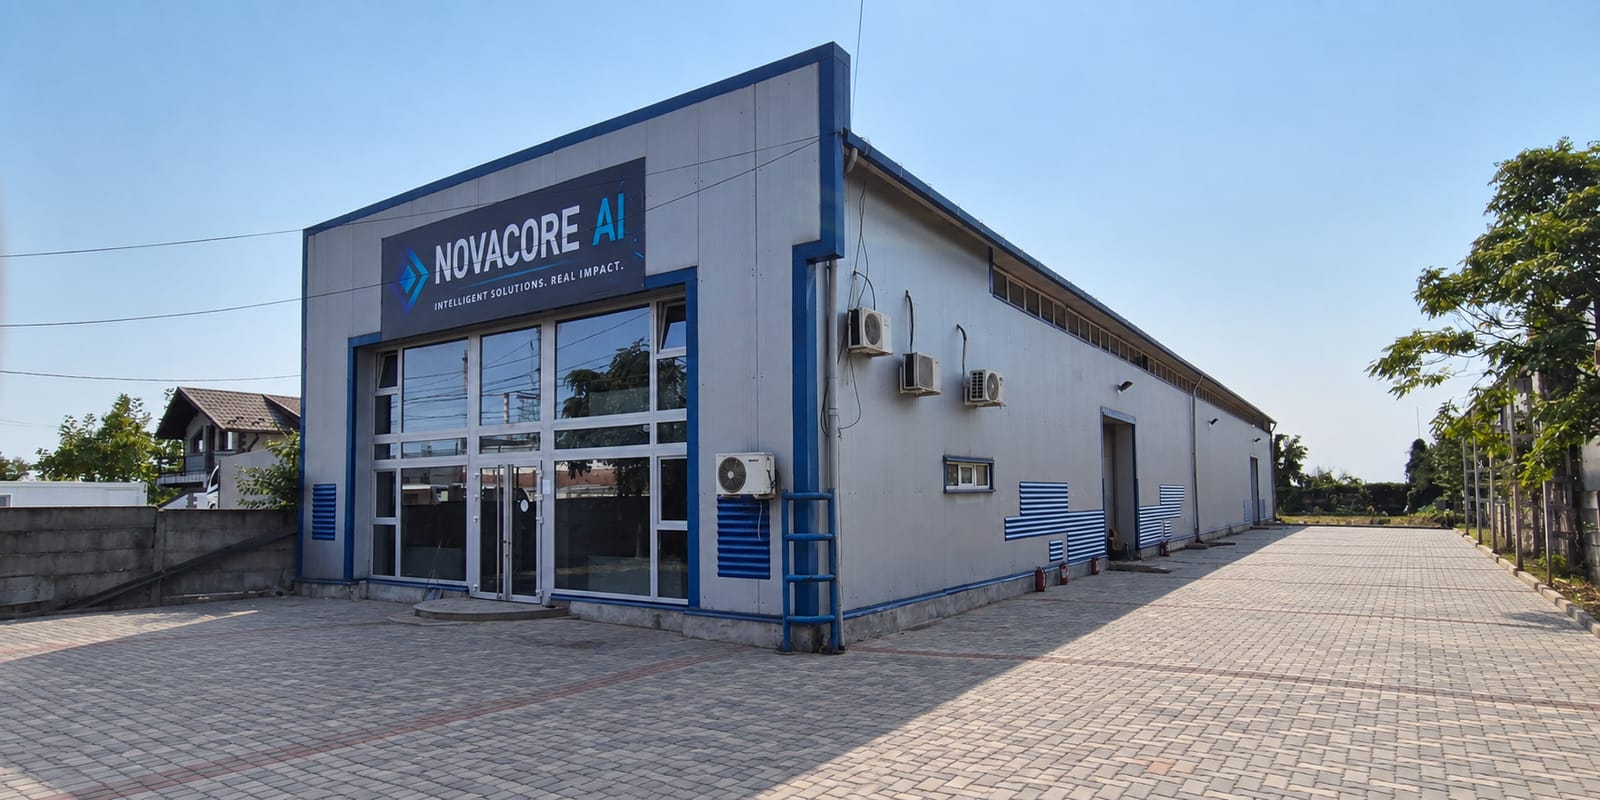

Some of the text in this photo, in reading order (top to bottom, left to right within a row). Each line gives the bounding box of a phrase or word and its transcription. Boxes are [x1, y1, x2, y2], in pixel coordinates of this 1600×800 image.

[434, 192, 625, 285] NOVACORE AI
[434, 260, 624, 311] INTELLIGENT SOLUTIONS. REAL IMPACT.
